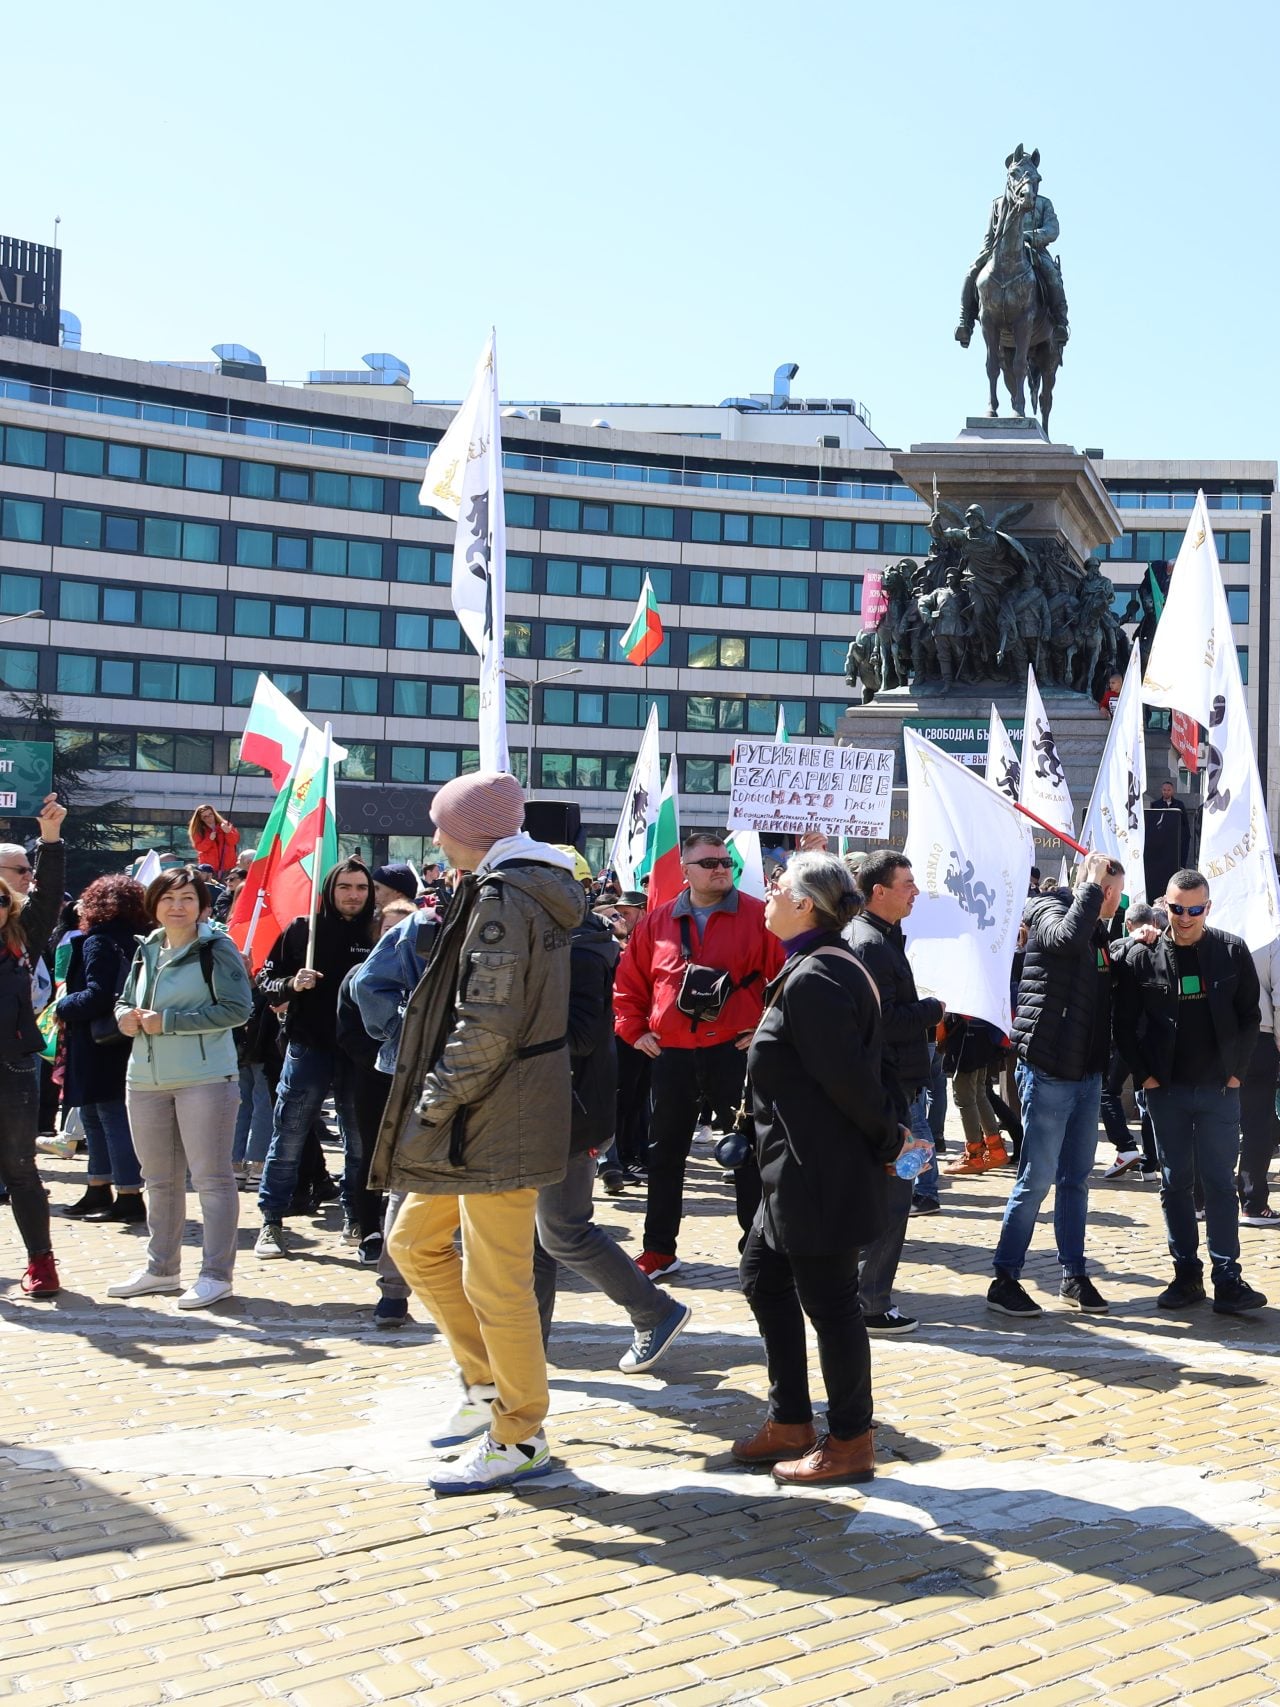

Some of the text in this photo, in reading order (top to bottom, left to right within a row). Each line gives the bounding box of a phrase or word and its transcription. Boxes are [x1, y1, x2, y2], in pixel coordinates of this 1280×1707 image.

[925, 728, 974, 741] СВОБОДНА
[977, 728, 1025, 740] БЪРИЯ
[736, 744, 893, 771] РУСИЯ НЕ Е ИРАК
[734, 767, 891, 795] БЪЛГАРИЯ НЕ Е
